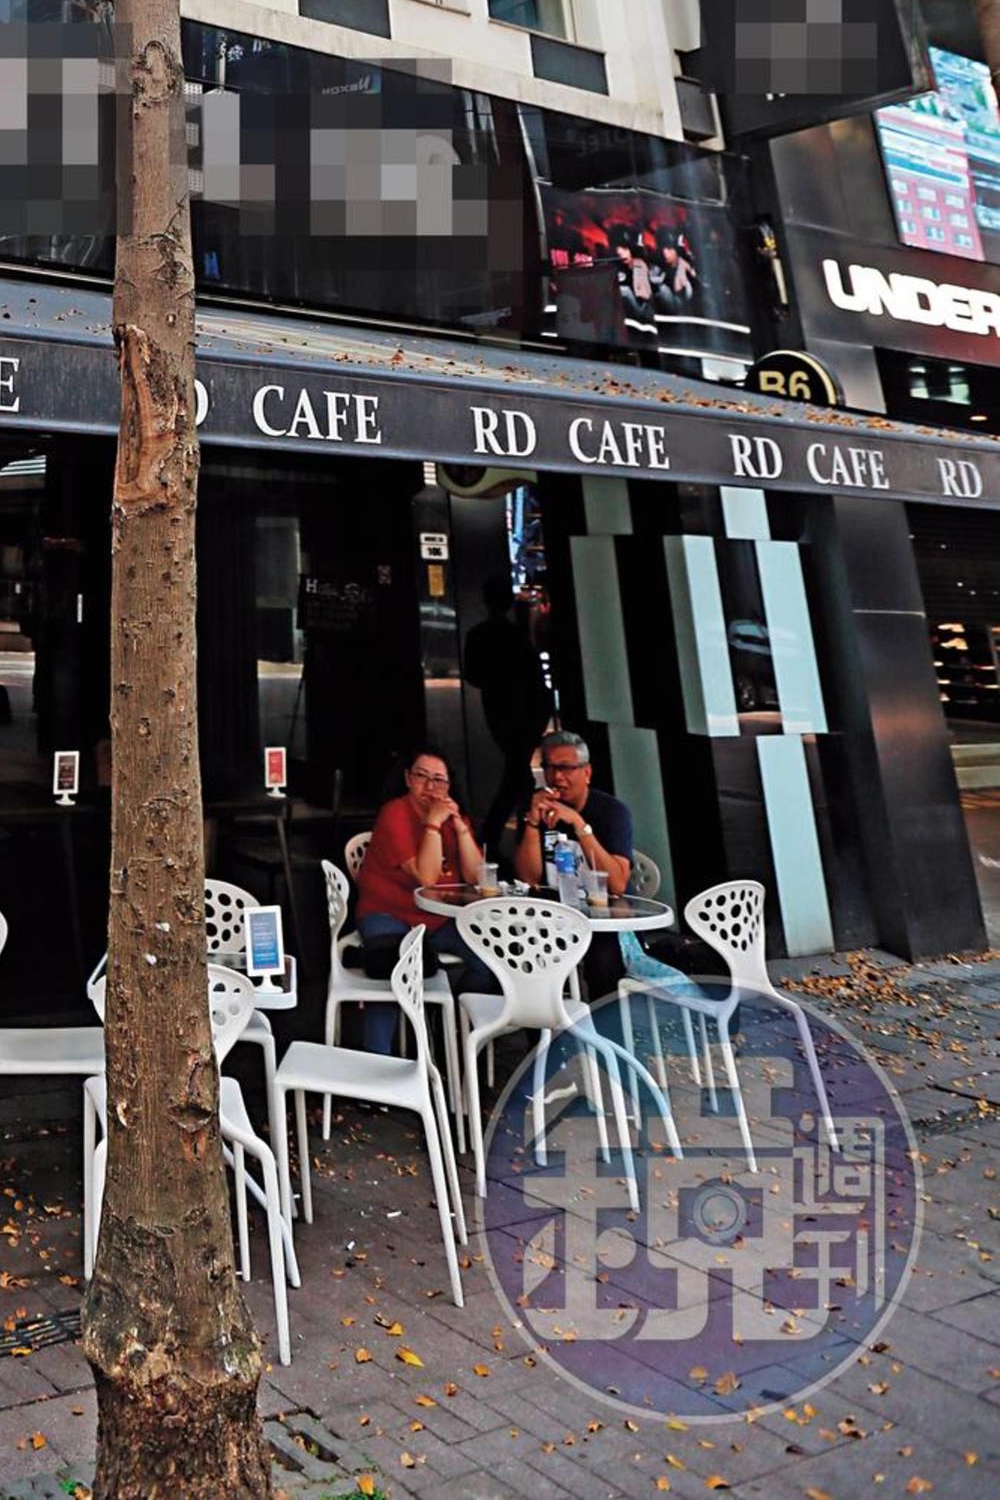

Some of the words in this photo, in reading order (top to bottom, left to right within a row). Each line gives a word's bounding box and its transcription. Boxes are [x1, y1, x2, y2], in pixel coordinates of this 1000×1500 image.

[252, 384, 382, 444] CAFE
[470, 406, 537, 456] RD
[568, 417, 670, 470] CAFE
[731, 434, 783, 479] RD
[806, 442, 890, 491] CAFE
[936, 458, 983, 498] RD
